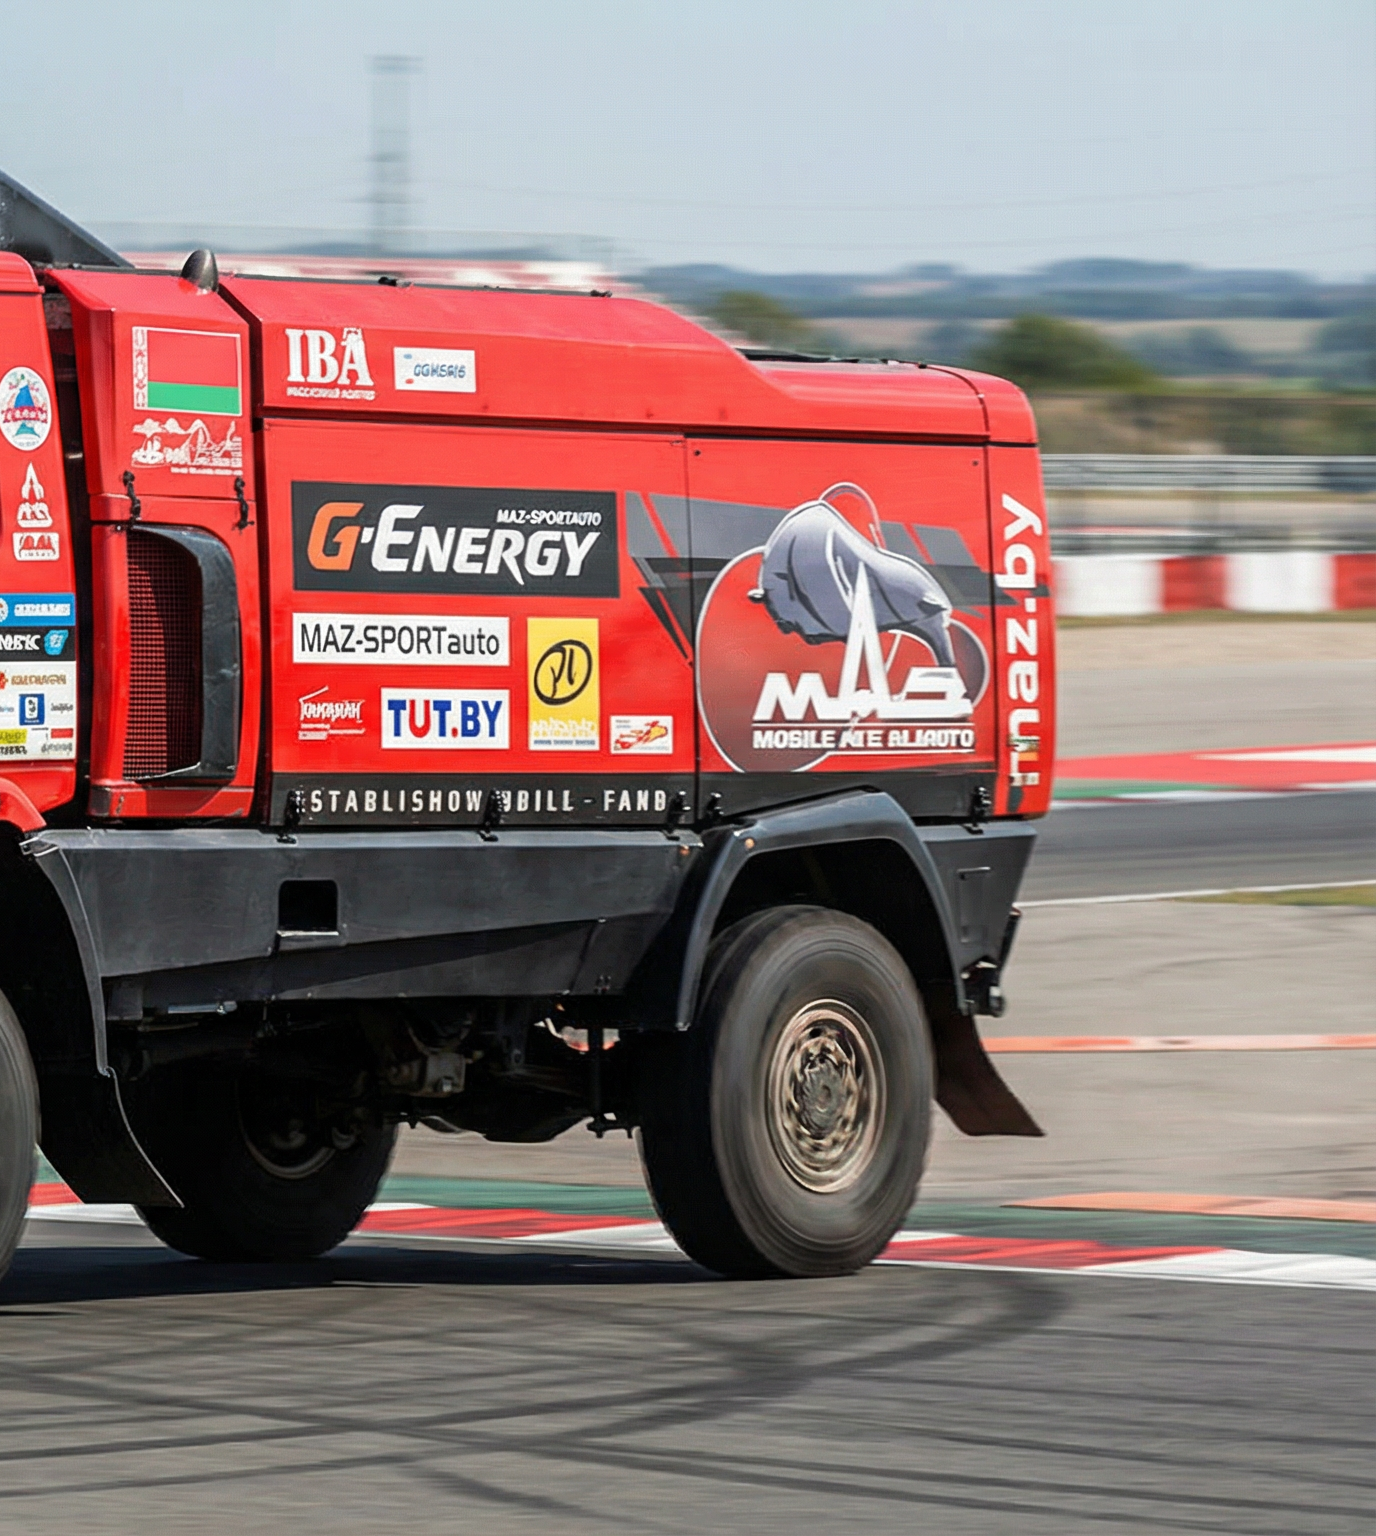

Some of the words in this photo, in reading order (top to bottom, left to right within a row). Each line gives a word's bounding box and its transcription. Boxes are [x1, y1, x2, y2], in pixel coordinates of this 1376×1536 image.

[285, 327, 375, 386] IBA
[300, 623, 500, 656] MAZ-SPORTauto
[387, 699, 503, 738] TUT.BY
